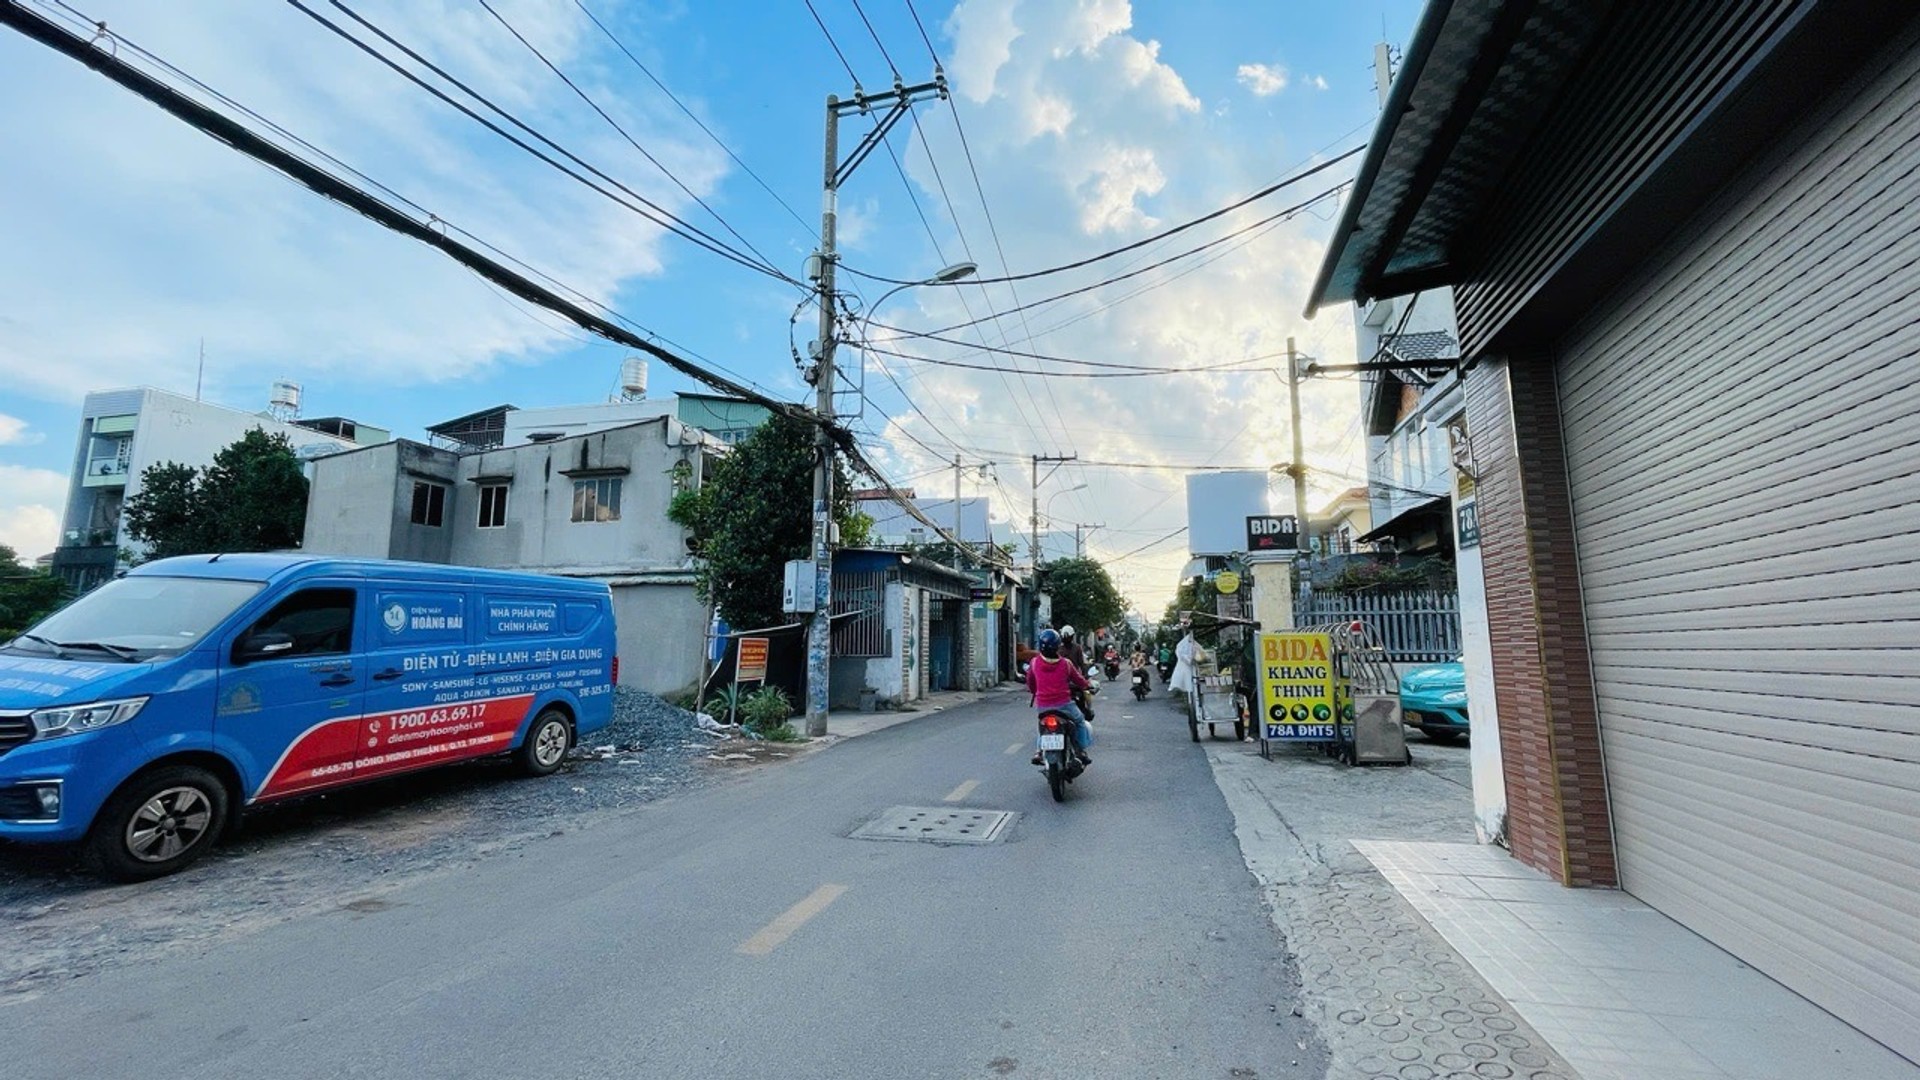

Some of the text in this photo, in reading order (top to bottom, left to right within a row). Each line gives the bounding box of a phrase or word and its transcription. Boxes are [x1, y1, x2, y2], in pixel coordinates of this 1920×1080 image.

[1251, 518, 1293, 535] BIDA
[490, 605, 556, 619] NHÀ PHÂN PHỐI
[411, 613, 464, 630] HOÀNG HẢI
[498, 620, 549, 632] CHÍNH HÃNG
[1263, 638, 1328, 661] BIDA
[403, 653, 438, 673] ĐIỆN
[441, 650, 461, 668] TỬ
[499, 651, 529, 667] LẠNH
[561, 649, 577, 660] GIA
[1267, 666, 1327, 679] KHANG
[402, 682, 428, 693] SONY
[1272, 685, 1326, 702] THỊNH
[433, 692, 459, 703] AQUA
[389, 704, 486, 731] 1900.63.69.17
[387, 721, 485, 744] dienmayhoanghai.vn
[1269, 725, 1295, 737] 78A
[1297, 725, 1335, 737] ĐHT5
[412, 744, 440, 757] THUẬN
